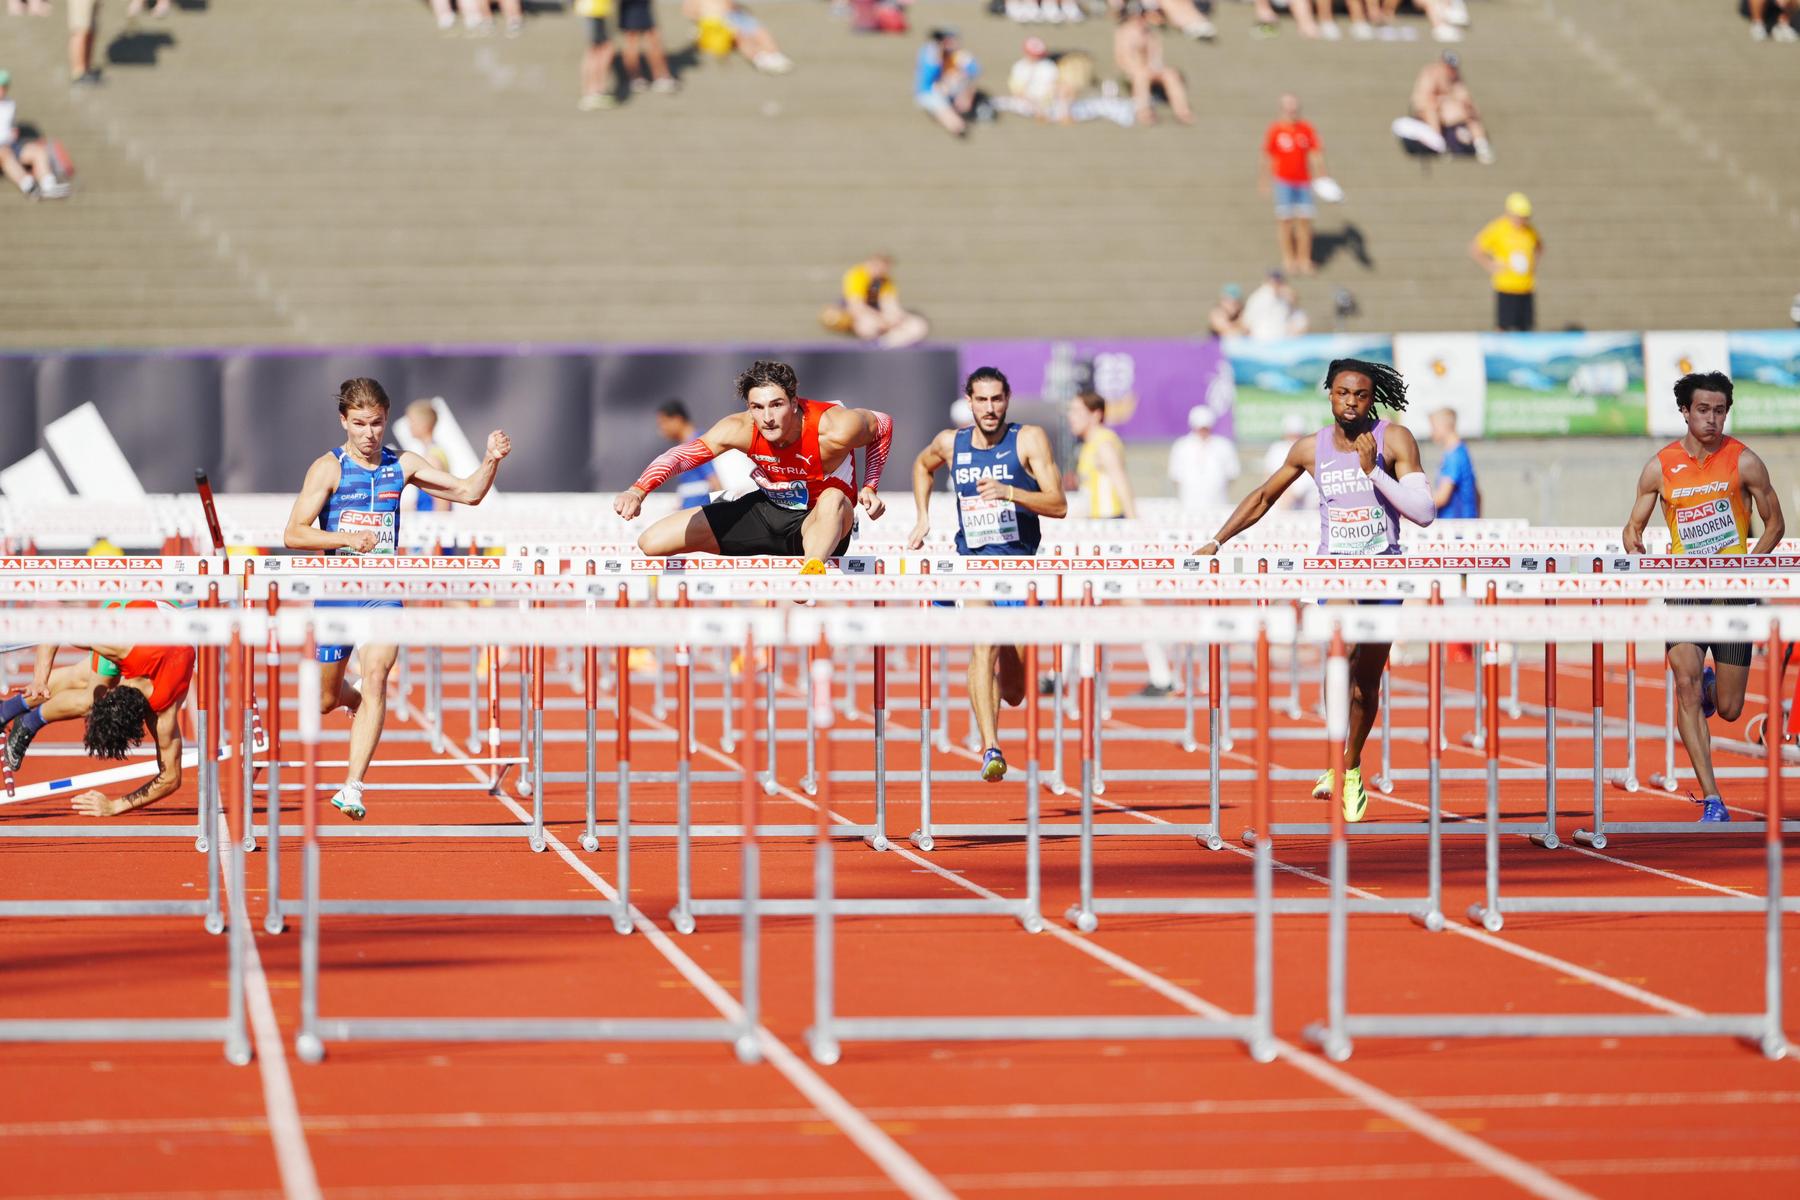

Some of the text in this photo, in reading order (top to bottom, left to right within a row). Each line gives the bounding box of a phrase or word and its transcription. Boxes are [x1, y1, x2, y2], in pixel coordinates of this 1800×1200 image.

[762, 464, 807, 475] USTRIA
[956, 464, 1014, 484] ISRAEL
[1321, 468, 1368, 484] GREA
[763, 489, 803, 499] ESSL
[1672, 481, 1729, 498] ESPAÑA
[341, 512, 382, 526] SPAR
[1330, 509, 1369, 522] SPAR
[1678, 504, 1714, 523] SPAR
[1331, 522, 1385, 539] GORIOLA
[1679, 514, 1734, 541] LAMBORENA
[24, 559, 56, 569] BA
[59, 559, 91, 570] BA
[94, 559, 127, 570] BA
[130, 559, 162, 570] BA
[292, 558, 324, 568] BA
[327, 558, 359, 568] BA
[362, 558, 394, 568] BA
[397, 558, 430, 568] BA
[432, 558, 464, 568] BA
[468, 558, 500, 568] BA
[632, 558, 664, 570] BA
[666, 558, 699, 570] BA
[701, 558, 734, 570] BA
[736, 558, 769, 569] BA
[772, 558, 803, 569] BA
[967, 560, 999, 570] BA
[1002, 559, 1034, 570] BA
[1037, 559, 1069, 570] BA
[1072, 559, 1104, 569] BA
[1107, 559, 1139, 569] BA
[1142, 559, 1174, 569] BA
[1304, 558, 1336, 570] BA
[1339, 558, 1372, 569] BA
[1374, 558, 1406, 569] BA
[1408, 558, 1440, 569] BA
[1443, 558, 1476, 568] BA
[1478, 558, 1510, 568] BA
[1640, 558, 1672, 570] BA
[1674, 558, 1706, 569] BA
[1710, 558, 1741, 568] BA
[1744, 557, 1776, 568] BA
